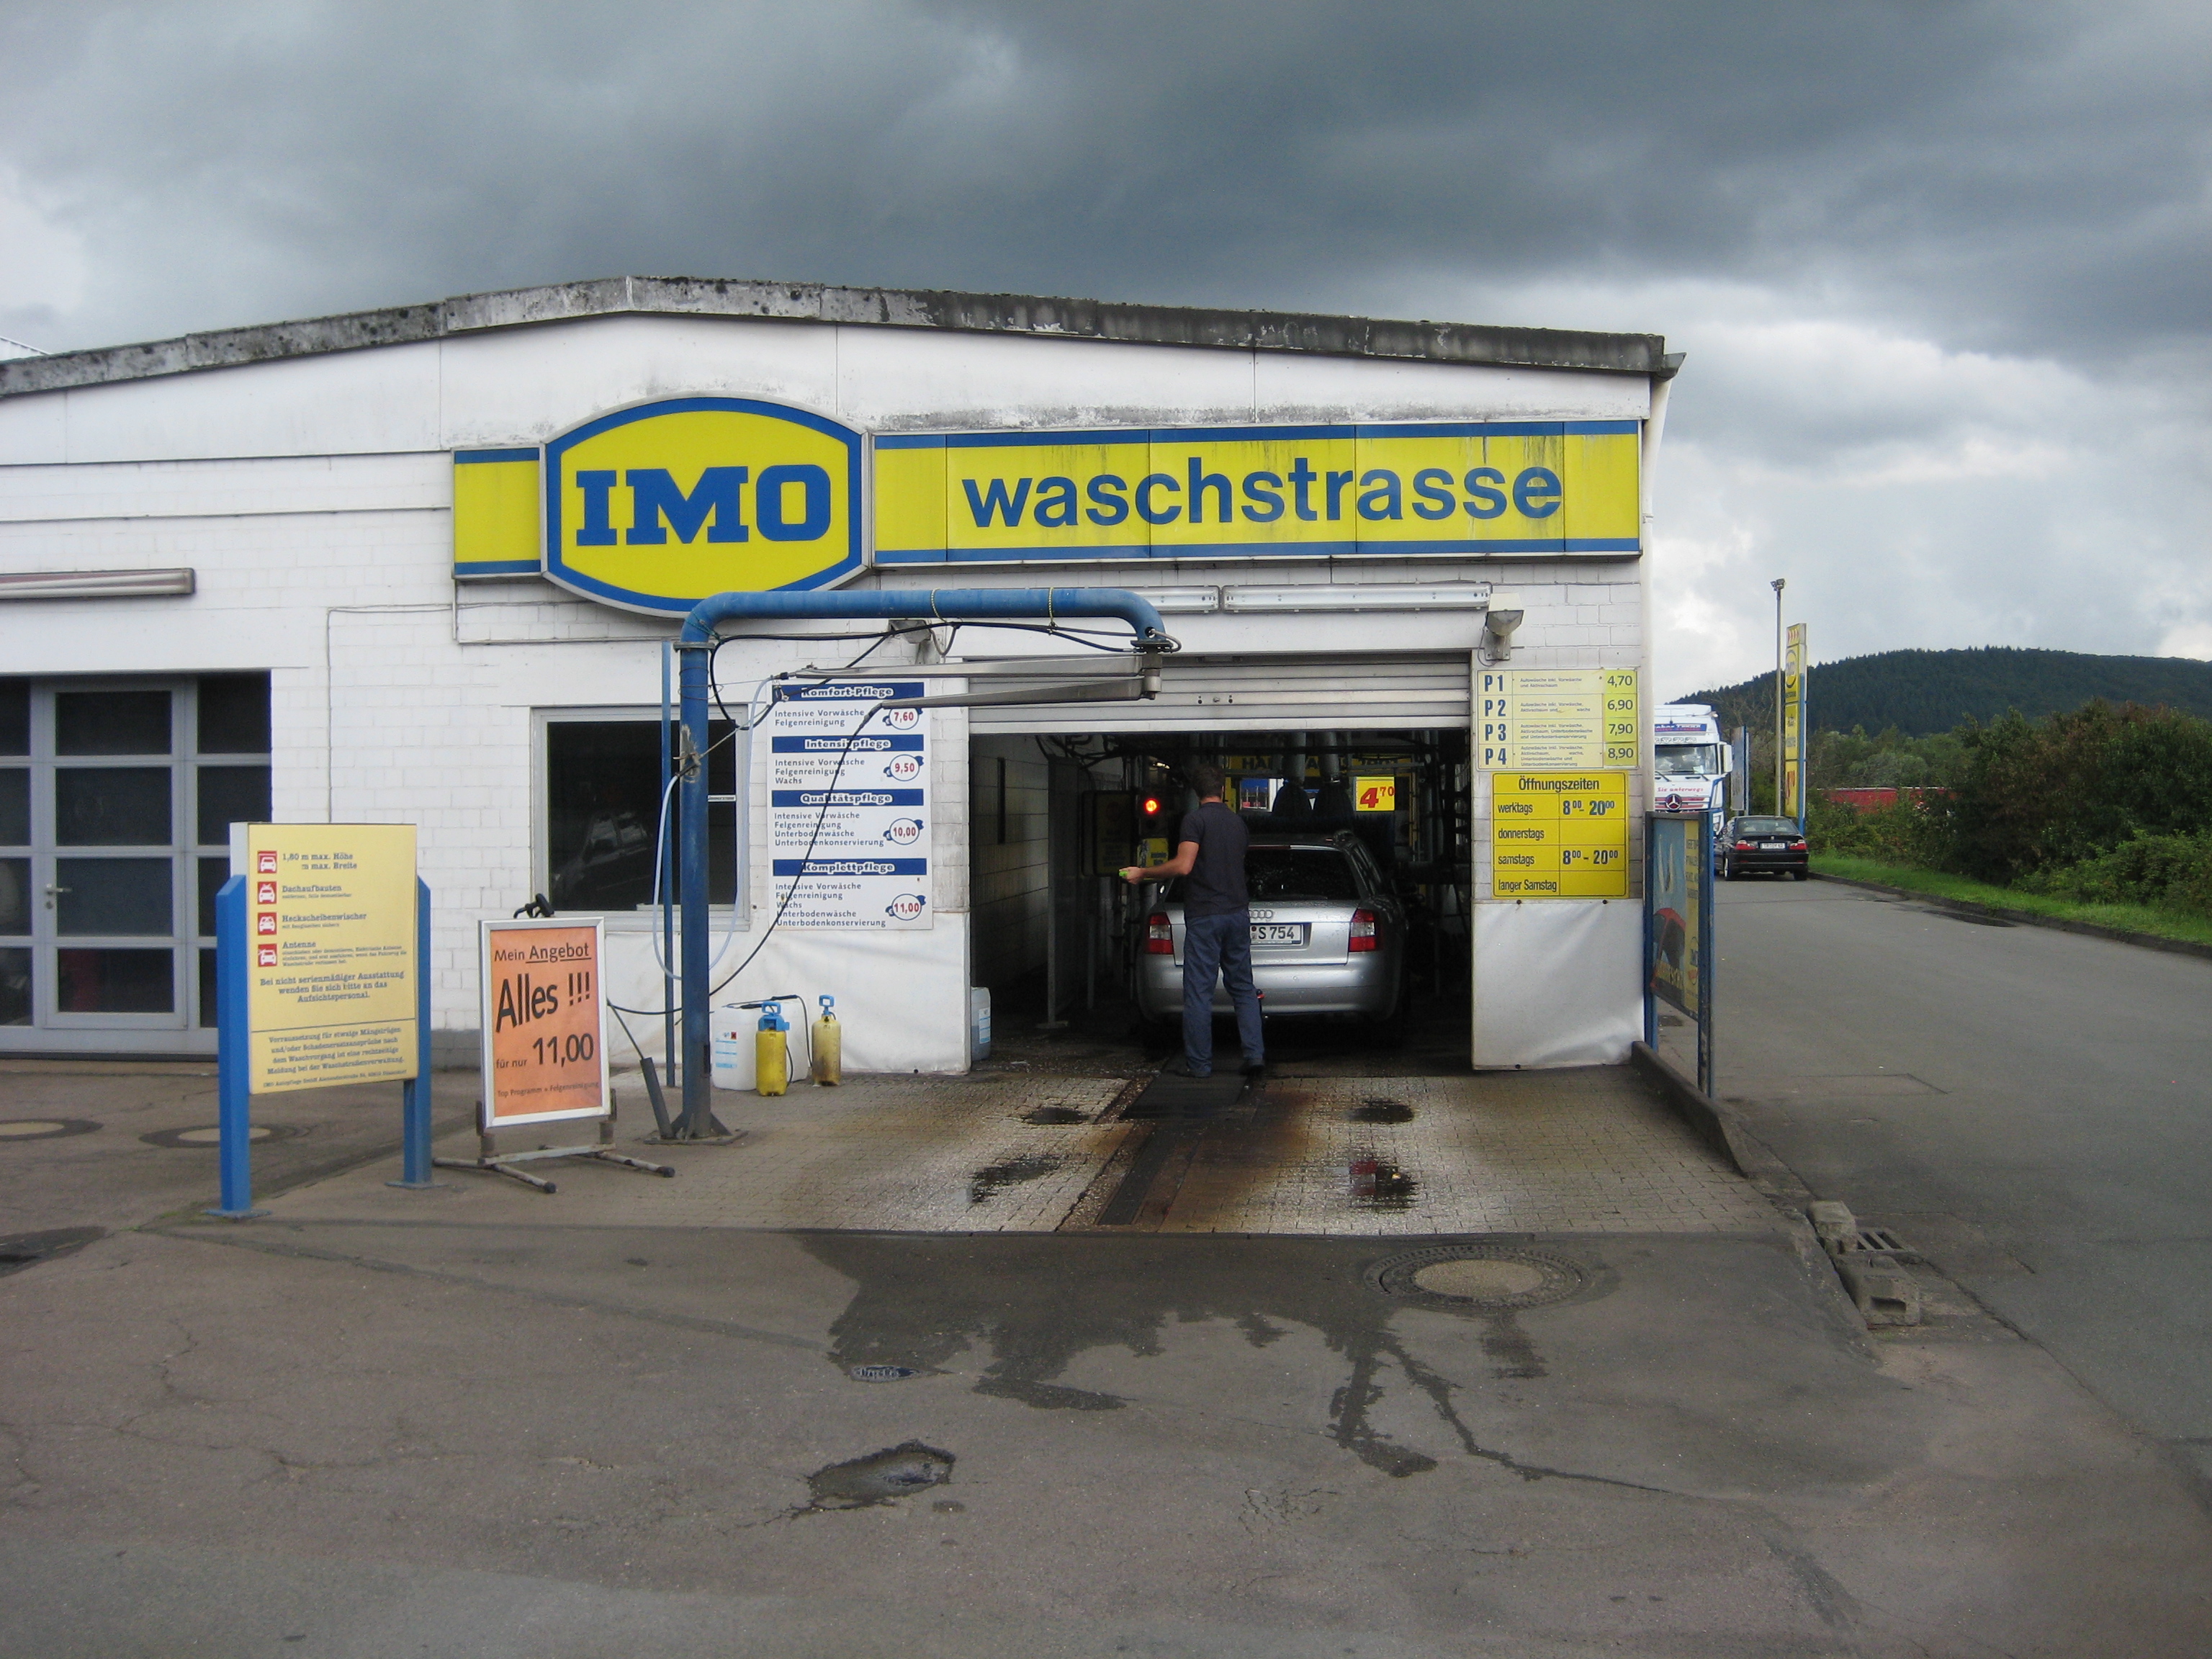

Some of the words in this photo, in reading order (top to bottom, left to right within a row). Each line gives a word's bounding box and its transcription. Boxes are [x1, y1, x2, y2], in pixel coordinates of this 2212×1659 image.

[961, 457, 1563, 528] waschstrasse
[576, 464, 831, 546] IMO
[1485, 675, 1493, 692] P
[1498, 675, 1503, 692] 1
[1607, 675, 1633, 687] 4,70
[802, 688, 893, 698] Komfort-Pflege
[1485, 700, 1493, 716] P
[1498, 700, 1506, 716] 2
[1607, 700, 1633, 711] 6,90
[775, 719, 845, 727] Felgenreinigung
[894, 712, 914, 723] 7,60
[1485, 724, 1493, 741] P
[1498, 724, 1506, 741] 3
[1609, 724, 1633, 736] 7,90
[1485, 748, 1493, 765] P
[1498, 748, 1507, 765] 4
[1608, 747, 1634, 760] 8,90
[894, 763, 915, 774] 9,50
[1519, 775, 1599, 793] Öffnungszeiten
[1498, 802, 1533, 815] werktags
[775, 821, 842, 830] Felgenreingung
[893, 827, 916, 838] 10,00
[1498, 828, 1545, 841] donnerstags
[775, 839, 884, 848] Unterbodenkonservierung
[282, 853, 300, 862] 1,80
[1498, 854, 1534, 867] samstags
[805, 863, 894, 873] Komplettpflege
[1498, 879, 1521, 892] langer
[1524, 879, 1557, 892] Samstag
[894, 903, 920, 914] 11,00
[282, 913, 367, 923] Heckscheibenwischer
[778, 919, 886, 927] Unterbodenkonservierung
[1270, 926, 1295, 940] 754
[495, 949, 525, 962] Mein
[529, 943, 590, 963] Angebot
[275, 976, 297, 985] nicht
[298, 974, 356, 985] serienmäßiger
[358, 971, 405, 980] Ausstattung
[279, 986, 310, 994] wenden
[297, 991, 371, 1003] Aufsichtspersonal.
[495, 972, 558, 1033] Alles
[495, 1058, 509, 1069] für
[511, 1058, 528, 1068] nur
[533, 1033, 594, 1068] 11,00
[511, 1086, 543, 1097] Programm
